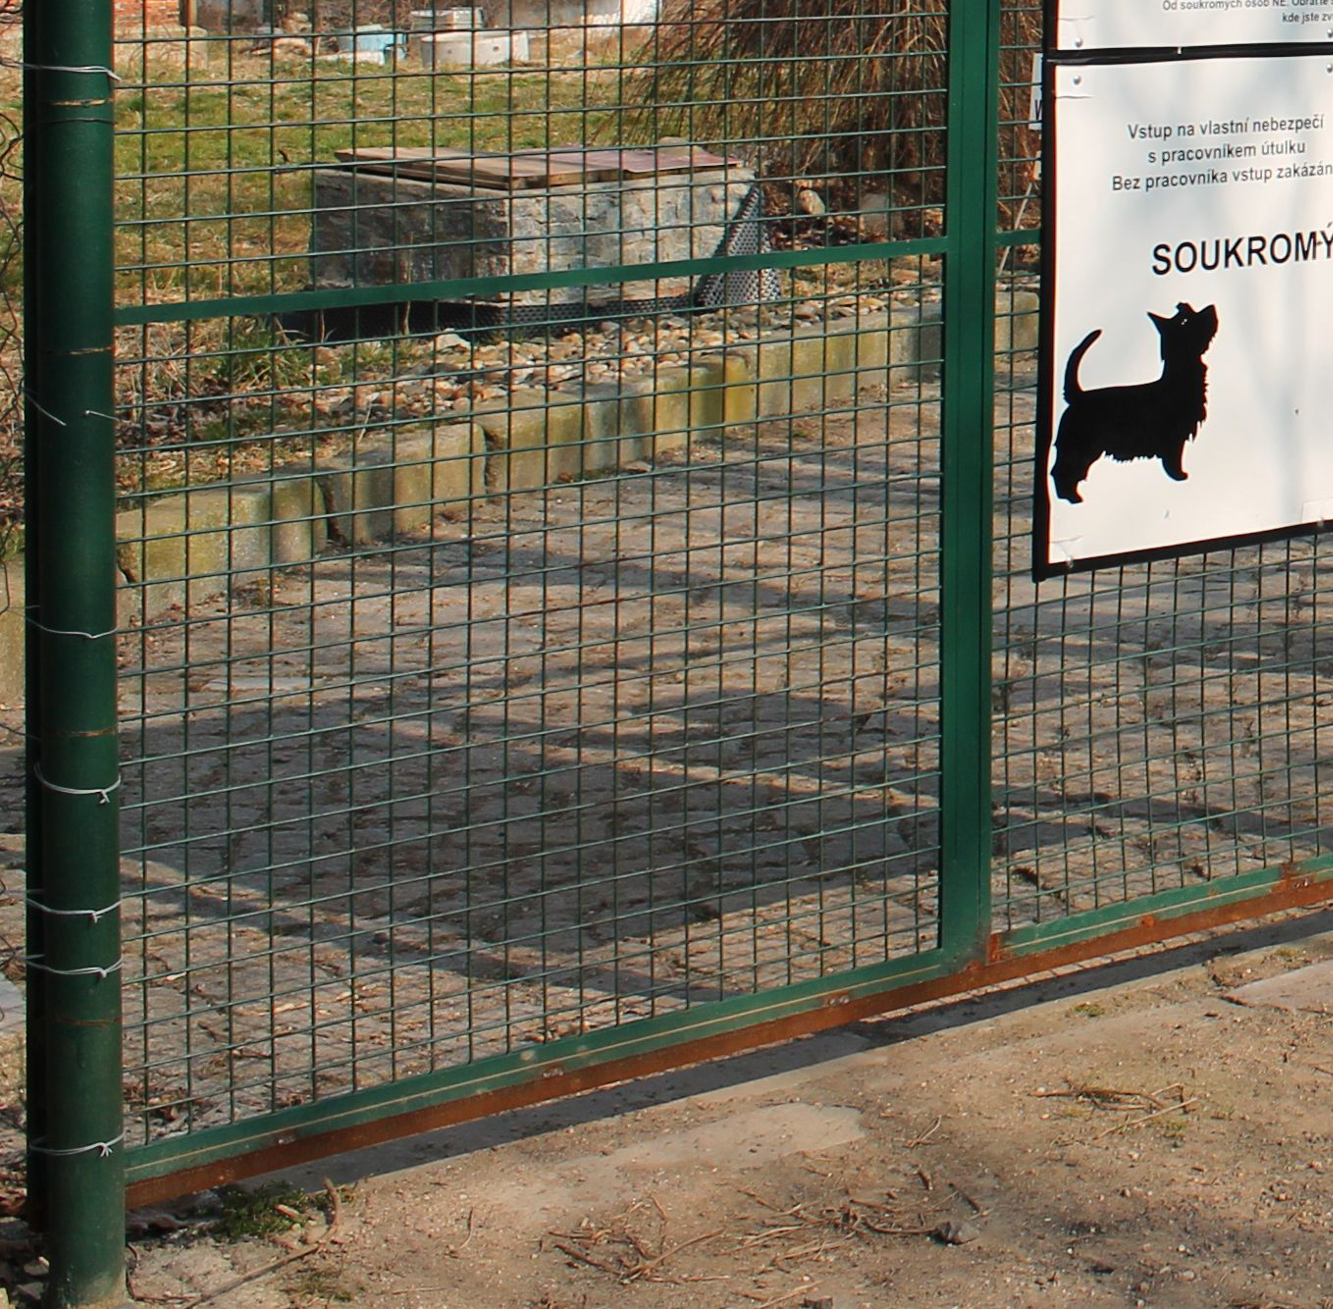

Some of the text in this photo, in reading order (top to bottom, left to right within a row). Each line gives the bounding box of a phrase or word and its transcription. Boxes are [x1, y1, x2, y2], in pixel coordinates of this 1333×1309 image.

[1163, 0, 1177, 10] Od
[1180, 0, 1242, 10] soukromých
[1283, 13, 1299, 22] kde
[1302, 13, 1319, 24] jste
[1128, 113, 1325, 141] Vstup na vlastní nebezpečí
[1148, 139, 1305, 166] s pracovníkem útulku
[1112, 174, 1141, 192] Bez
[1145, 167, 1228, 192] pracovníka
[1232, 164, 1273, 183] vstup
